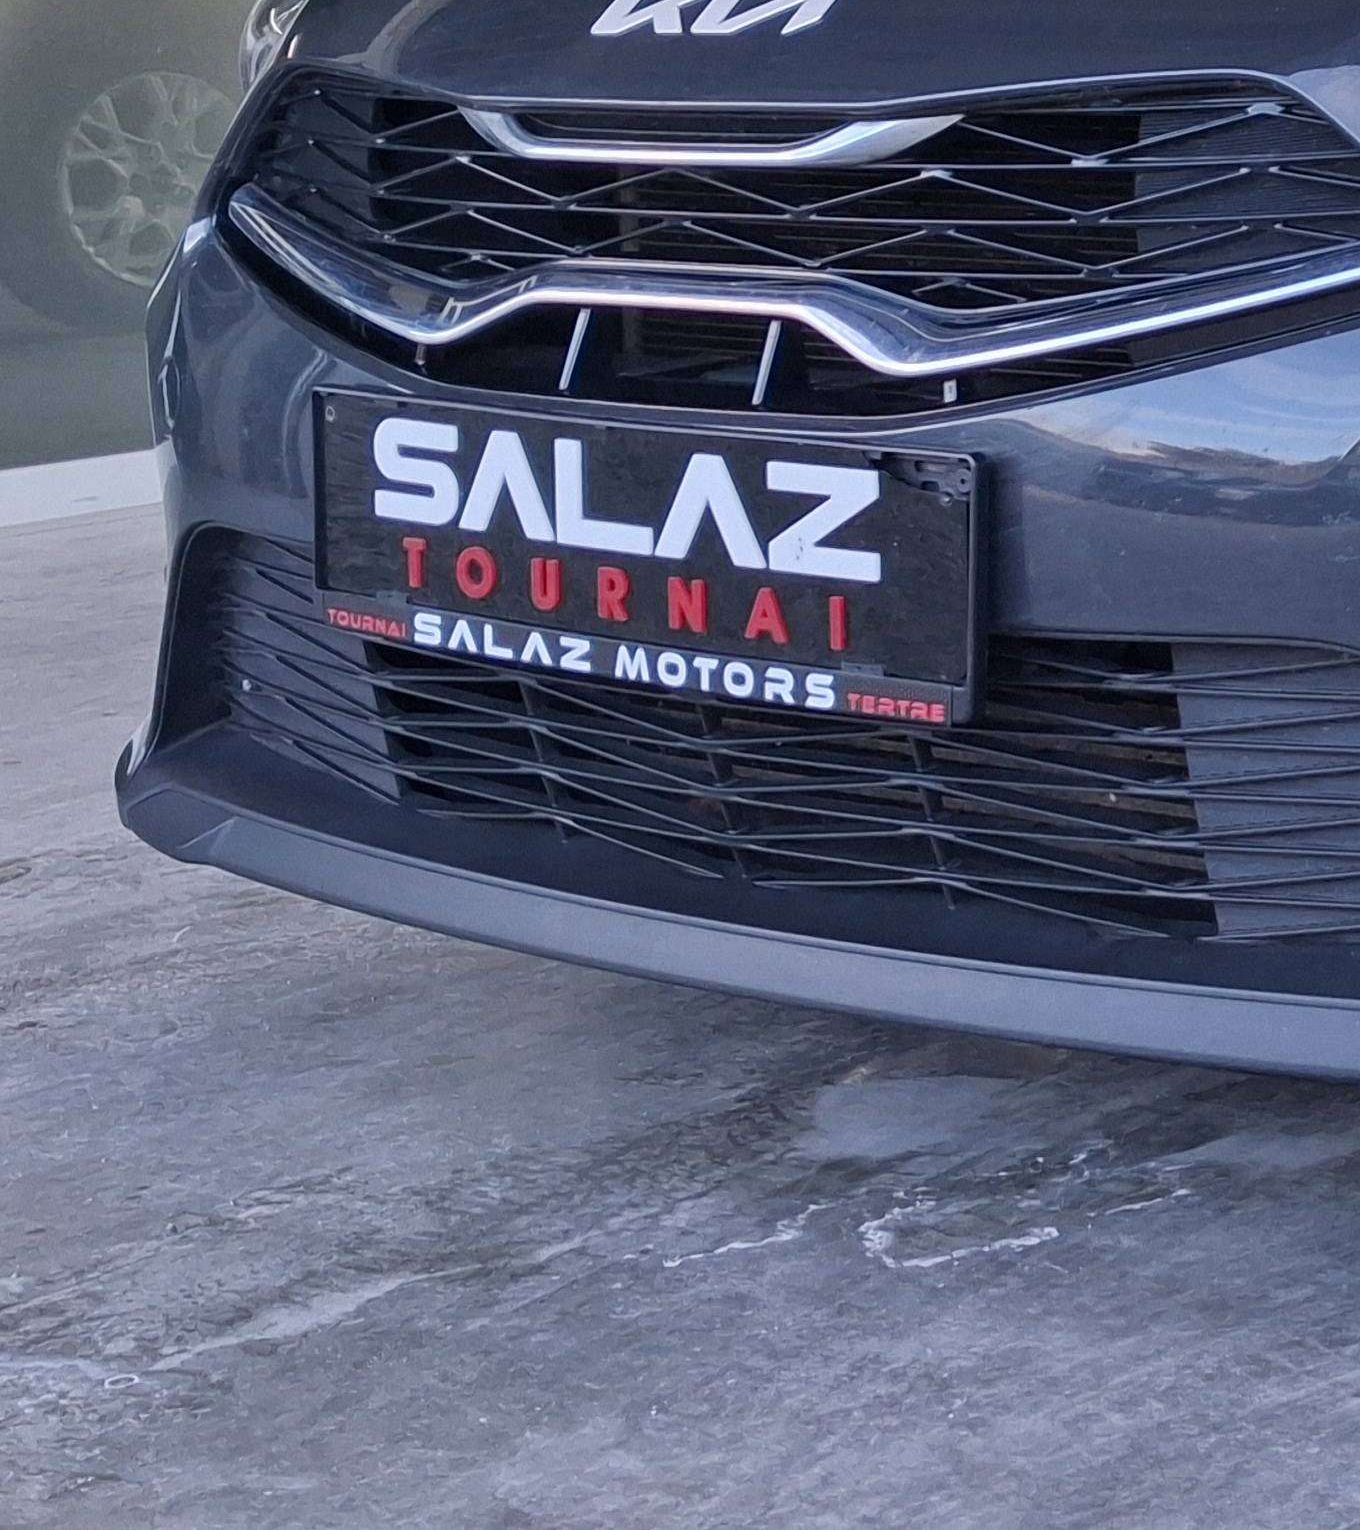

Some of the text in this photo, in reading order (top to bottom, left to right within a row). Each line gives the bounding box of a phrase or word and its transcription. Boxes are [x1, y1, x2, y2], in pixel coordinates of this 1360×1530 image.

[373, 417, 882, 583] SALAZ
[402, 536, 849, 651] TOURNAI
[327, 607, 946, 723] TOURNAI SALAZ MOTORS TERTRE
